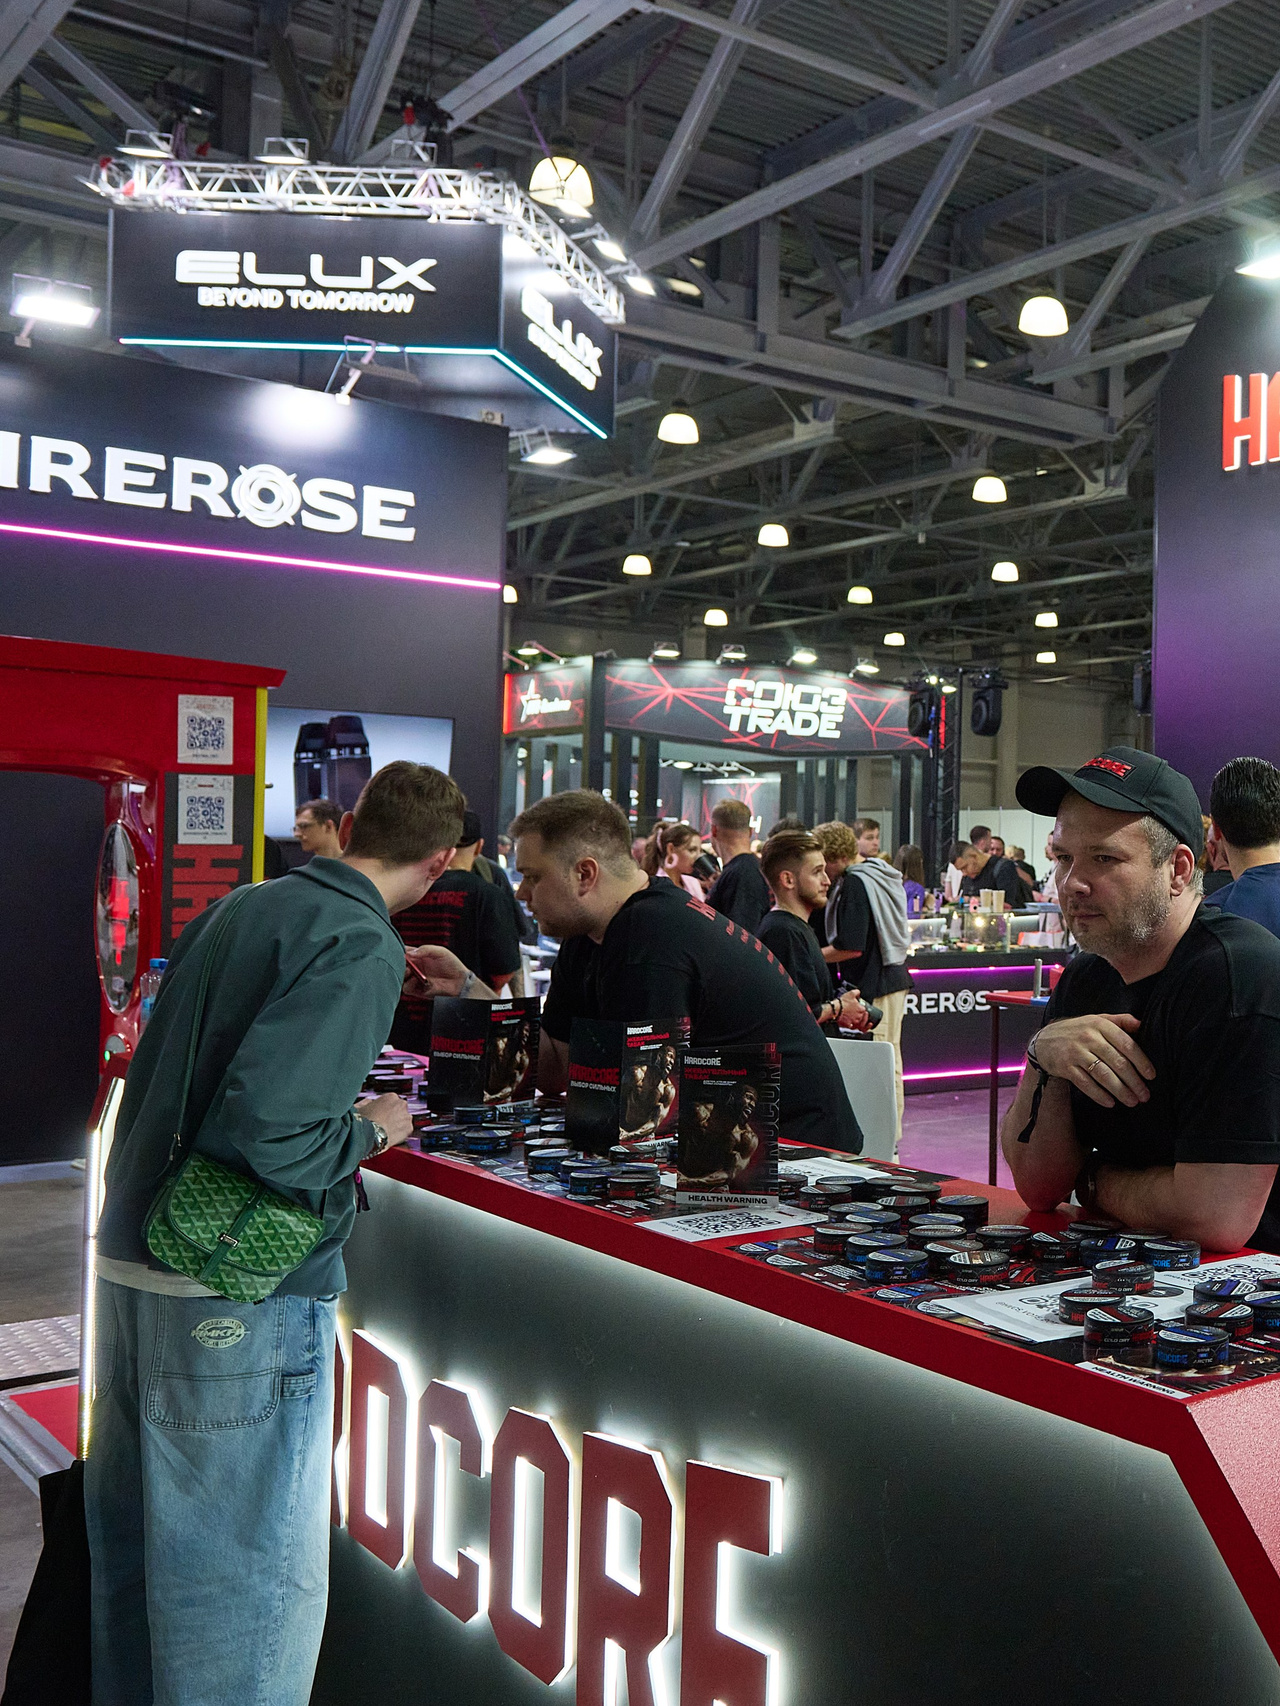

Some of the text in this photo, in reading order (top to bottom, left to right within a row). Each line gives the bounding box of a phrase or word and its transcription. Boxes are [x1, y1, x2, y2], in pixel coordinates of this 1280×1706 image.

[175, 249, 438, 292] ELUX
[197, 285, 415, 314] BEYOND TOMORROW
[722, 705, 845, 739] TRADE
[1072, 757, 1132, 777] CORE
[902, 989, 1009, 1016] REROS
[684, 1055, 722, 1066] HARDCORE
[684, 1067, 747, 1076] ЖЕВАТЕЛЬНЫЙ
[570, 1080, 617, 1092] ВЫБОР СИЛЬНЫХ
[688, 1194, 768, 1205] HEALTH WARNING
[1091, 1366, 1176, 1396] HEALTH WARNING
[331, 1318, 784, 1706] DCORE
